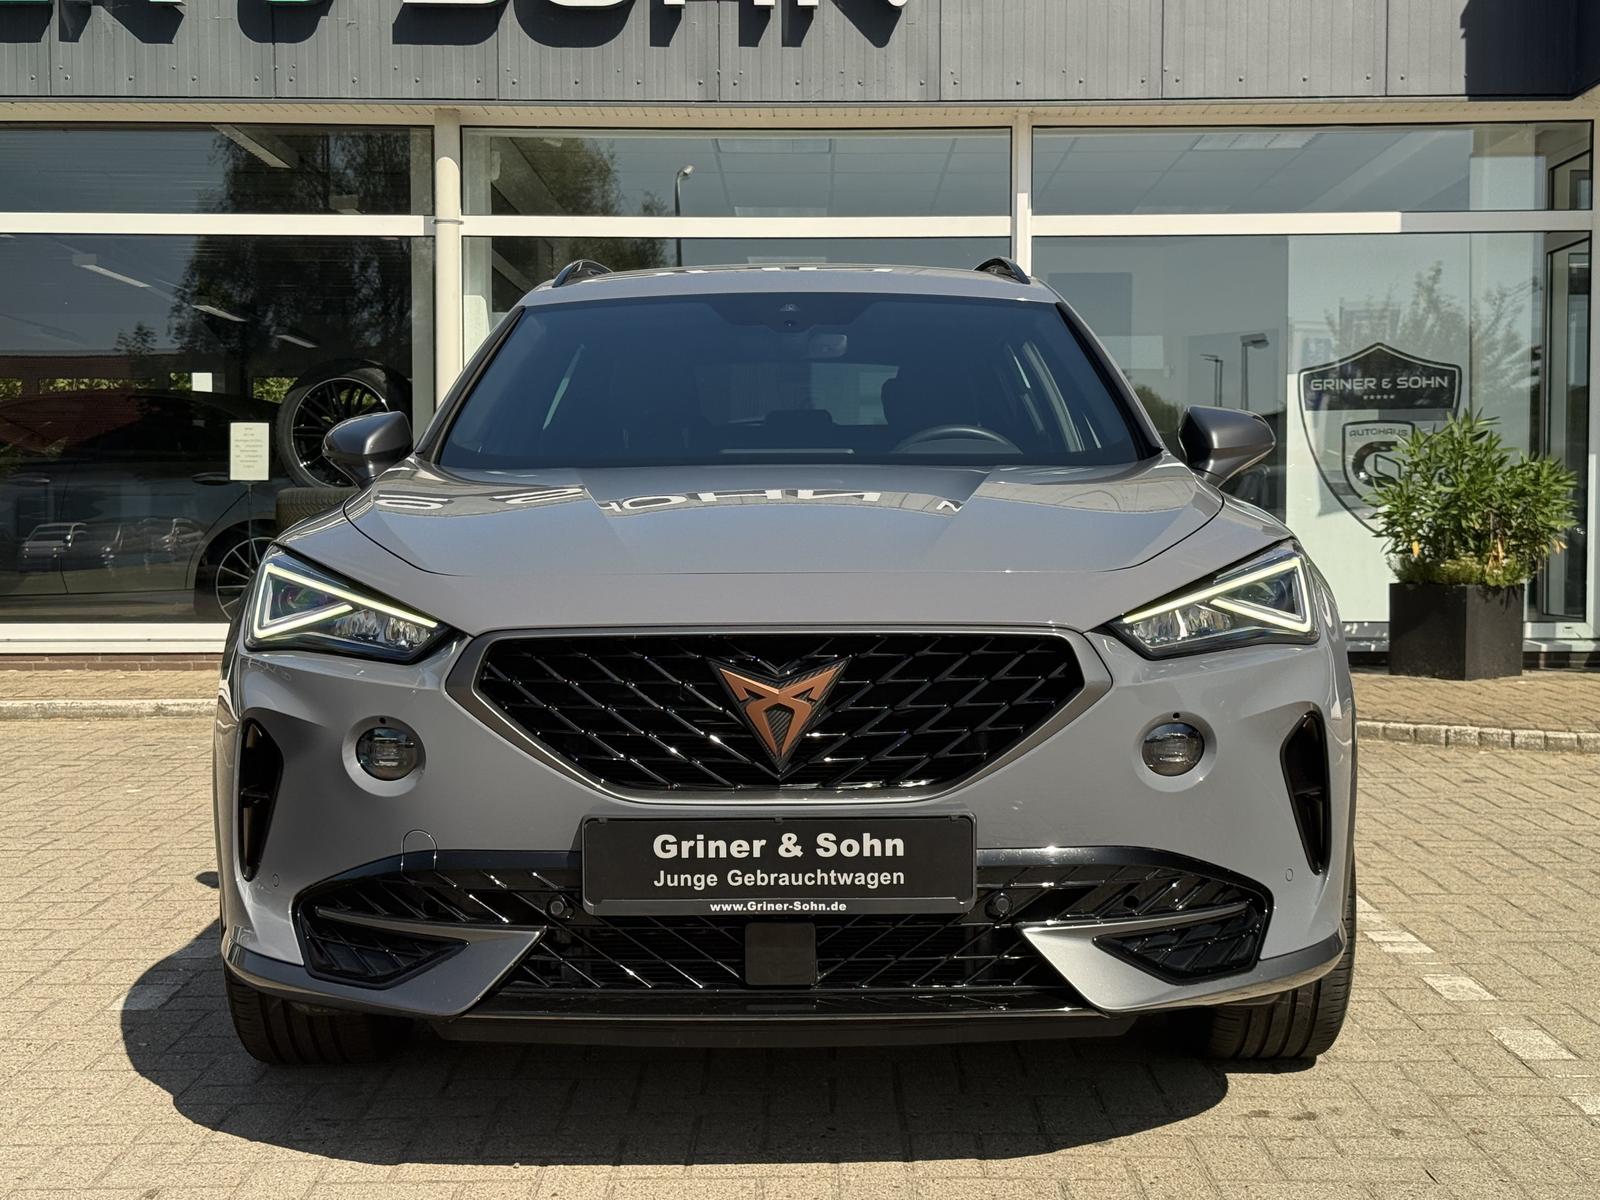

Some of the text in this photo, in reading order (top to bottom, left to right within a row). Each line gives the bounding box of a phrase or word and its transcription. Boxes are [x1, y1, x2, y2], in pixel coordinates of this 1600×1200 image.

[1310, 376, 1449, 391] GRINER & SOHN
[1349, 427, 1409, 437] AUTOHAUS
[653, 832, 905, 859] Griner & Sohn
[653, 869, 905, 891] Junge Gebrauchtwagen
[709, 900, 847, 912] www.Griner-Sohn.de
